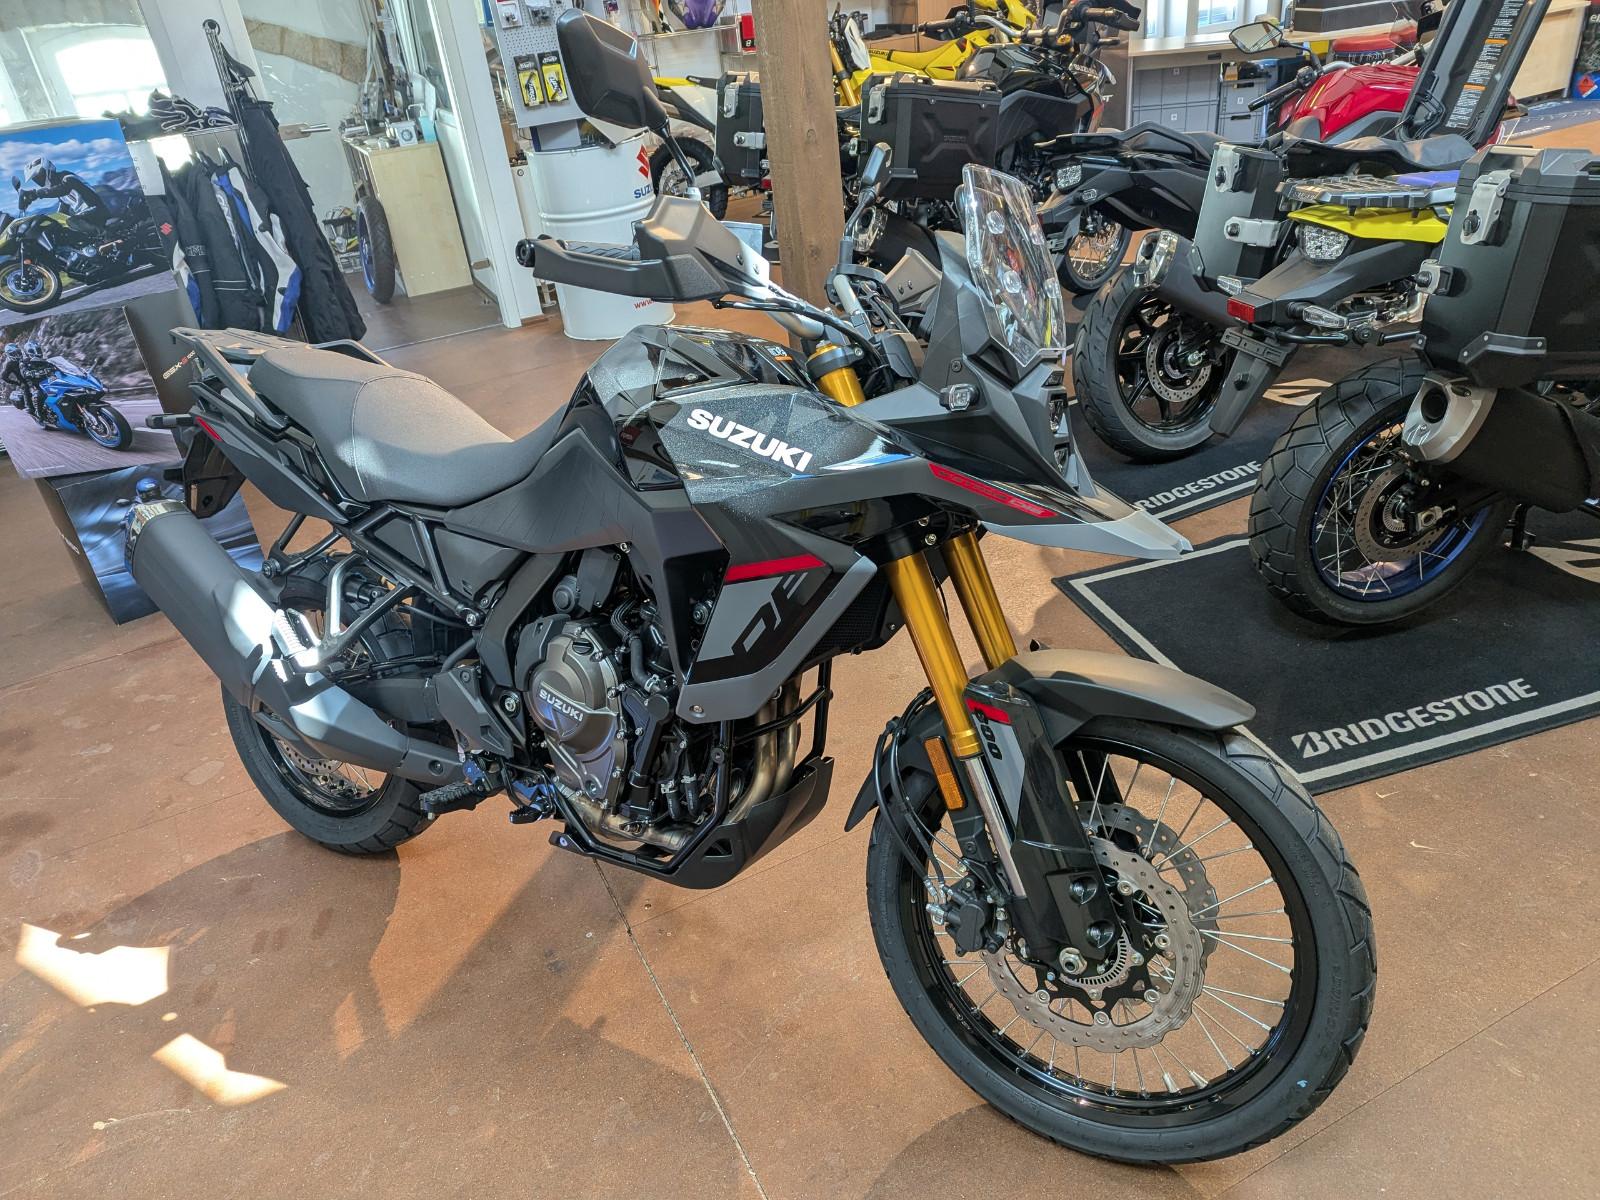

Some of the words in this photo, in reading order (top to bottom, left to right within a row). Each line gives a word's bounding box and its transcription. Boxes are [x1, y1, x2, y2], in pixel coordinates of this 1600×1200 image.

[633, 183, 652, 199] SUZ
[686, 408, 813, 472] SUZUKI
[1133, 460, 1262, 509] RIDGESTONE
[539, 688, 584, 722] SUZUKI
[1291, 678, 1539, 759] BRIDGESTONE
